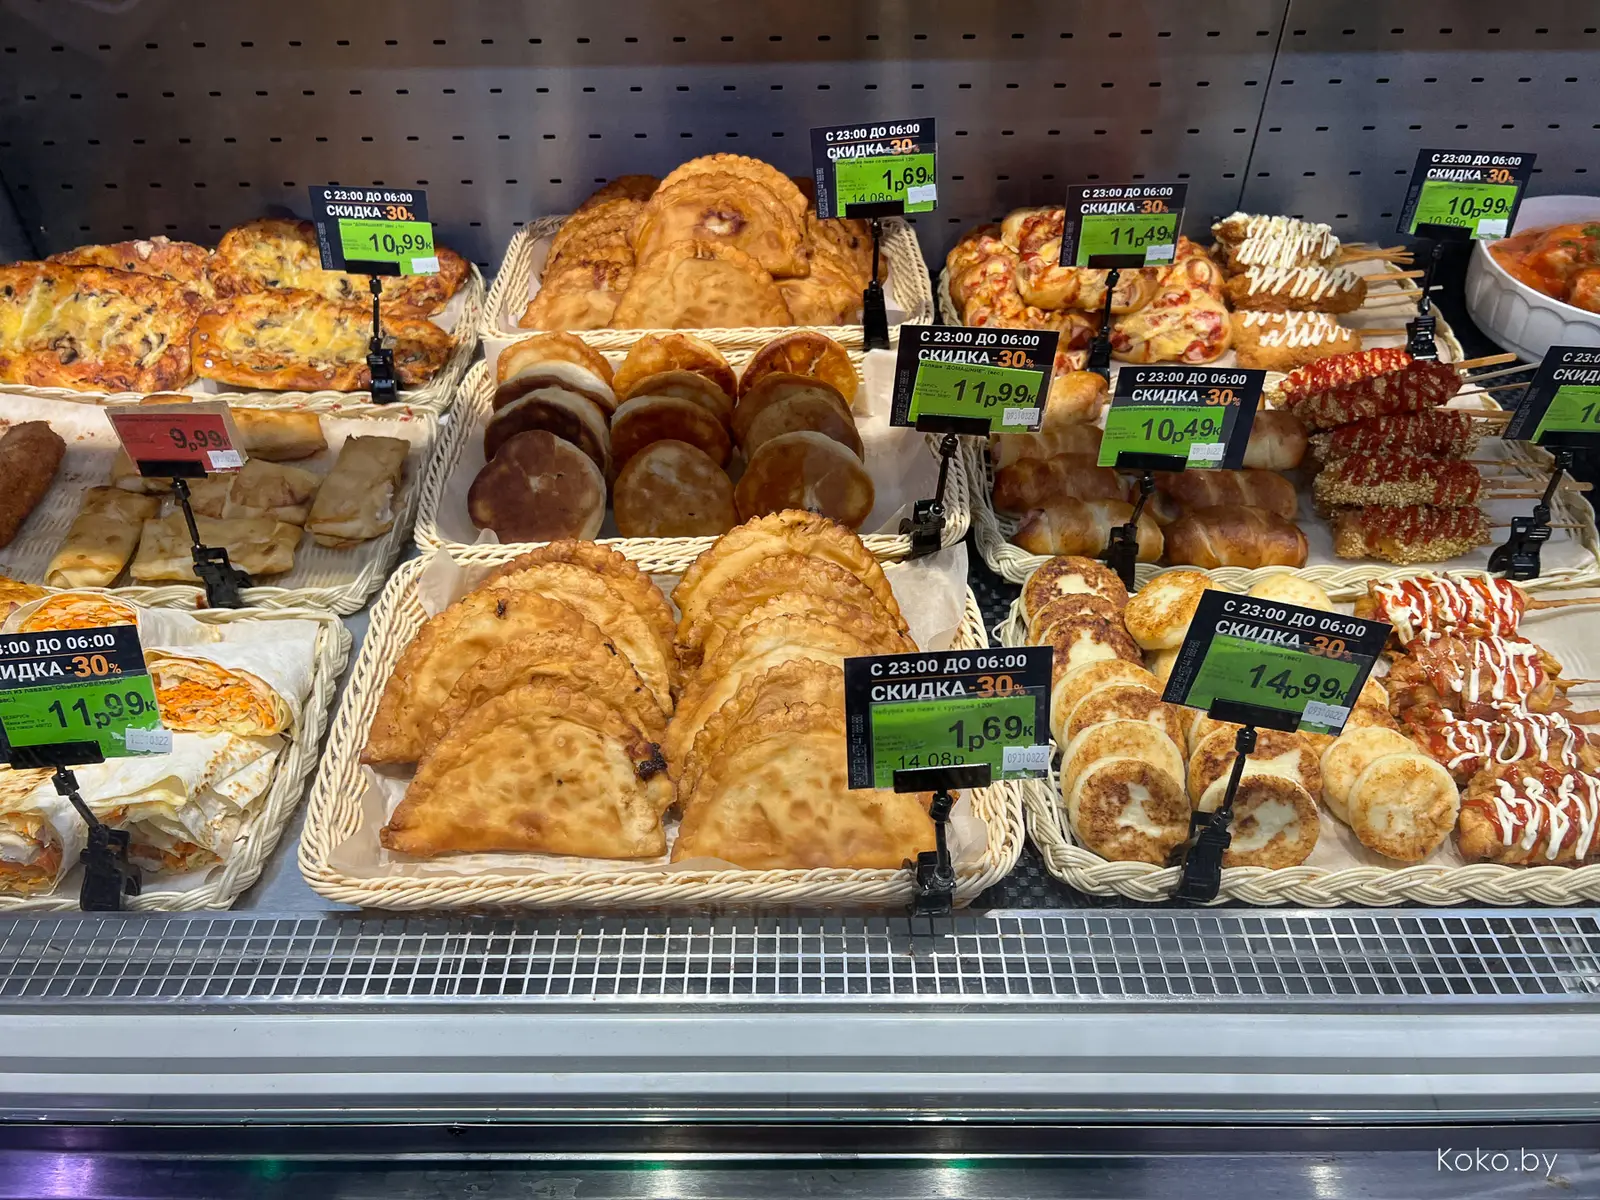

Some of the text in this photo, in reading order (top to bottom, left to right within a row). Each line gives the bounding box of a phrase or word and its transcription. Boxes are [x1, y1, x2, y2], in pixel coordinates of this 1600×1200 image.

[825, 123, 920, 142] С 23:00 ДО 06:00
[827, 143, 885, 159] СКИДКА
[1431, 153, 1522, 166] С 23:00 ДО 06:00
[882, 166, 934, 193] 1р69к
[1427, 168, 1515, 184] СКИДКА -30%
[324, 190, 413, 203] С 23:00 ДО 06:00
[1082, 187, 1173, 199] С 23:00 ДО 06:00
[326, 205, 415, 221] СКИДКА -30%
[1080, 200, 1169, 214] СКИДКА -30%
[1448, 196, 1512, 219] 10р99к
[369, 233, 433, 256] 10р99к
[1110, 225, 1174, 248] 11р49к
[920, 331, 1040, 346] С 23:00 ДО 06:00
[918, 349, 1036, 369] СКИДКА -30%
[1562, 352, 1573, 362] С
[1136, 372, 1248, 385] С 23:00 ДО 06:00
[953, 379, 1036, 408] 11р99к
[1131, 389, 1241, 407] СКИДКА -30%
[1141, 418, 1221, 444] 10р49к
[1223, 600, 1367, 638] С 23:00 ДО 06:00
[35, 638, 61, 655] ДО
[66, 633, 116, 650] 06:00
[1215, 620, 1352, 661] СКИДКА -30%
[0, 654, 123, 682] ИДКА -30%
[870, 654, 1027, 676] С 23:00 ДО 06:00
[871, 674, 1026, 701] СКИДКА -30%
[1248, 664, 1349, 700] 14р99к
[48, 691, 156, 729] 11р99к
[948, 715, 1034, 752] 1р69к
[1007, 752, 1045, 763] 09310822
